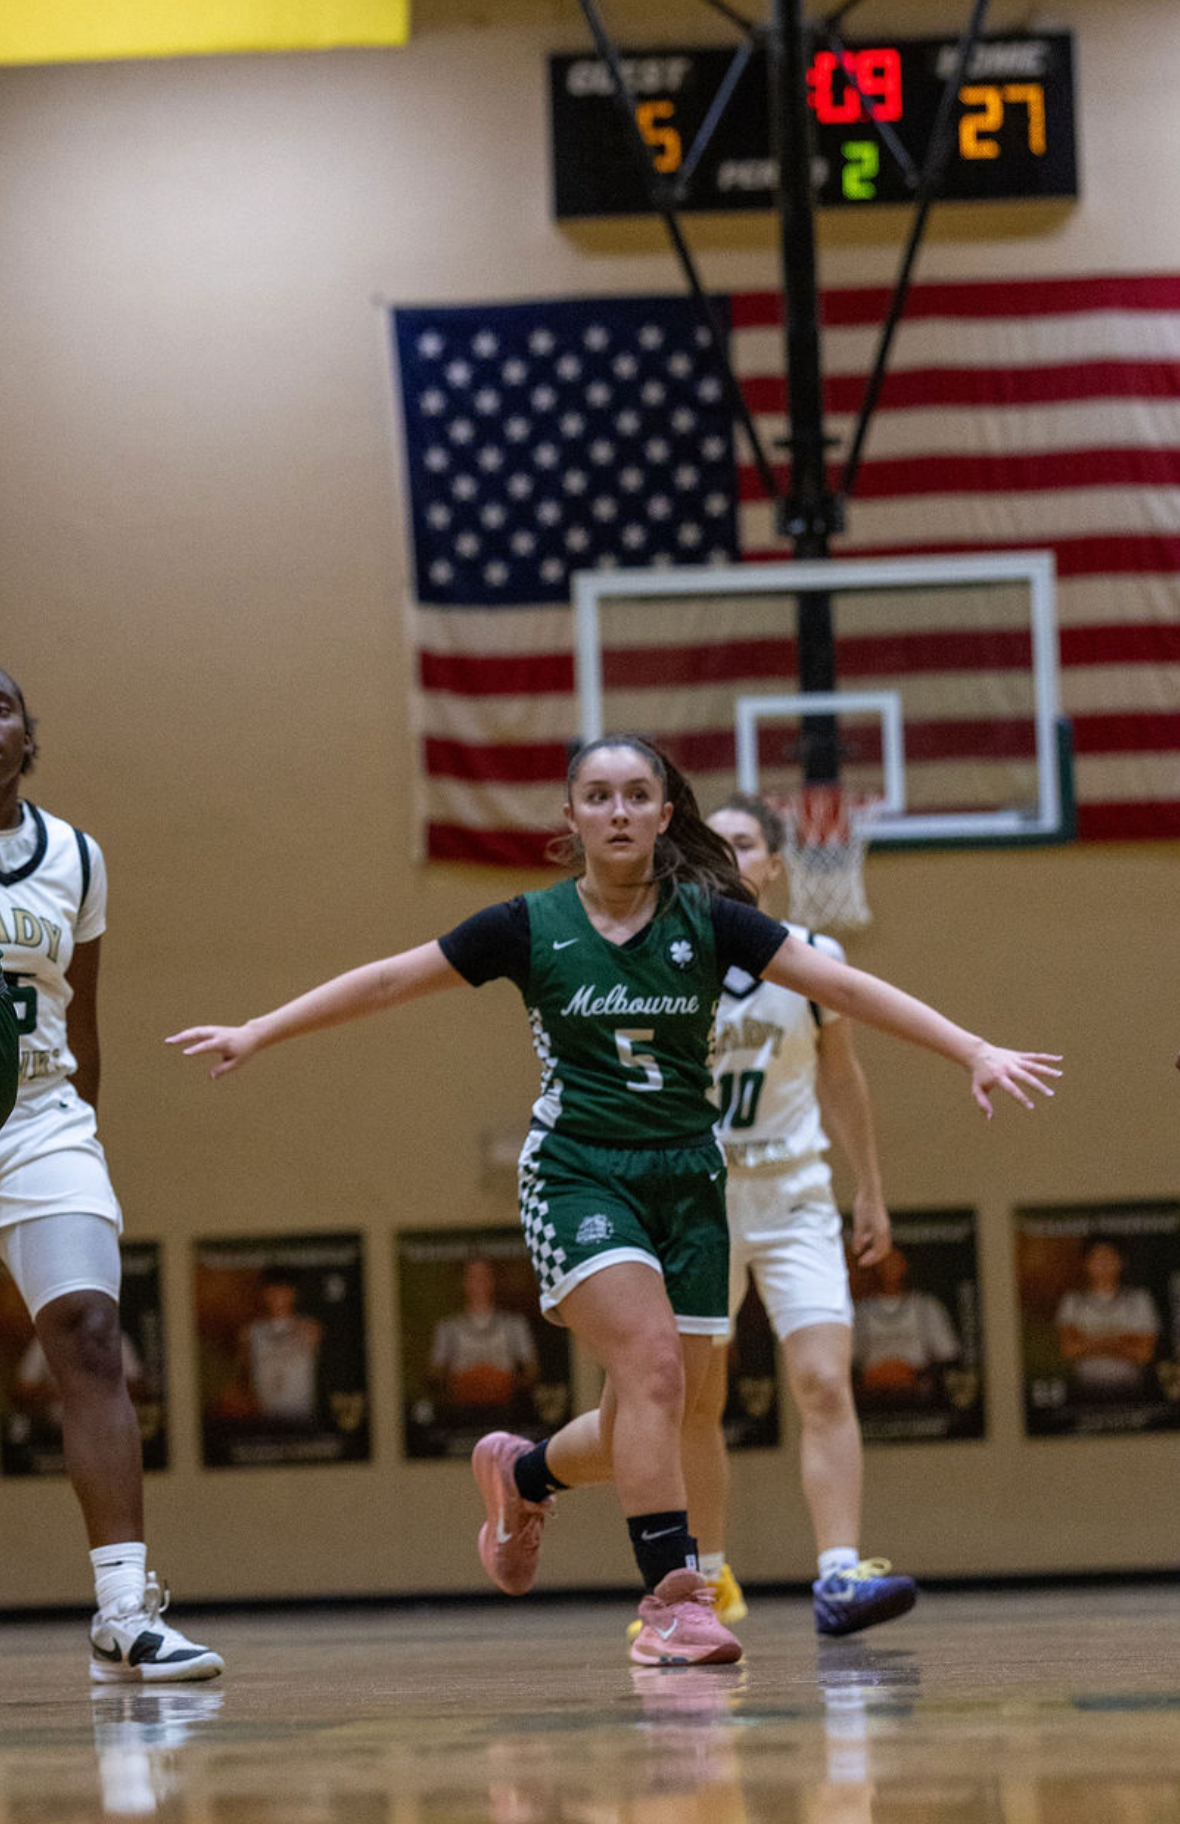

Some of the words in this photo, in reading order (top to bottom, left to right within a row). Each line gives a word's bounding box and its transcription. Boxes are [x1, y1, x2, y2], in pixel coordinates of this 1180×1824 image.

[635, 101, 681, 173] 5
[958, 84, 1047, 160] 27
[842, 141, 880, 200] 2
[561, 984, 699, 1017] Melbourne
[615, 1029, 664, 1092] 5
[718, 1070, 765, 1130] 10
